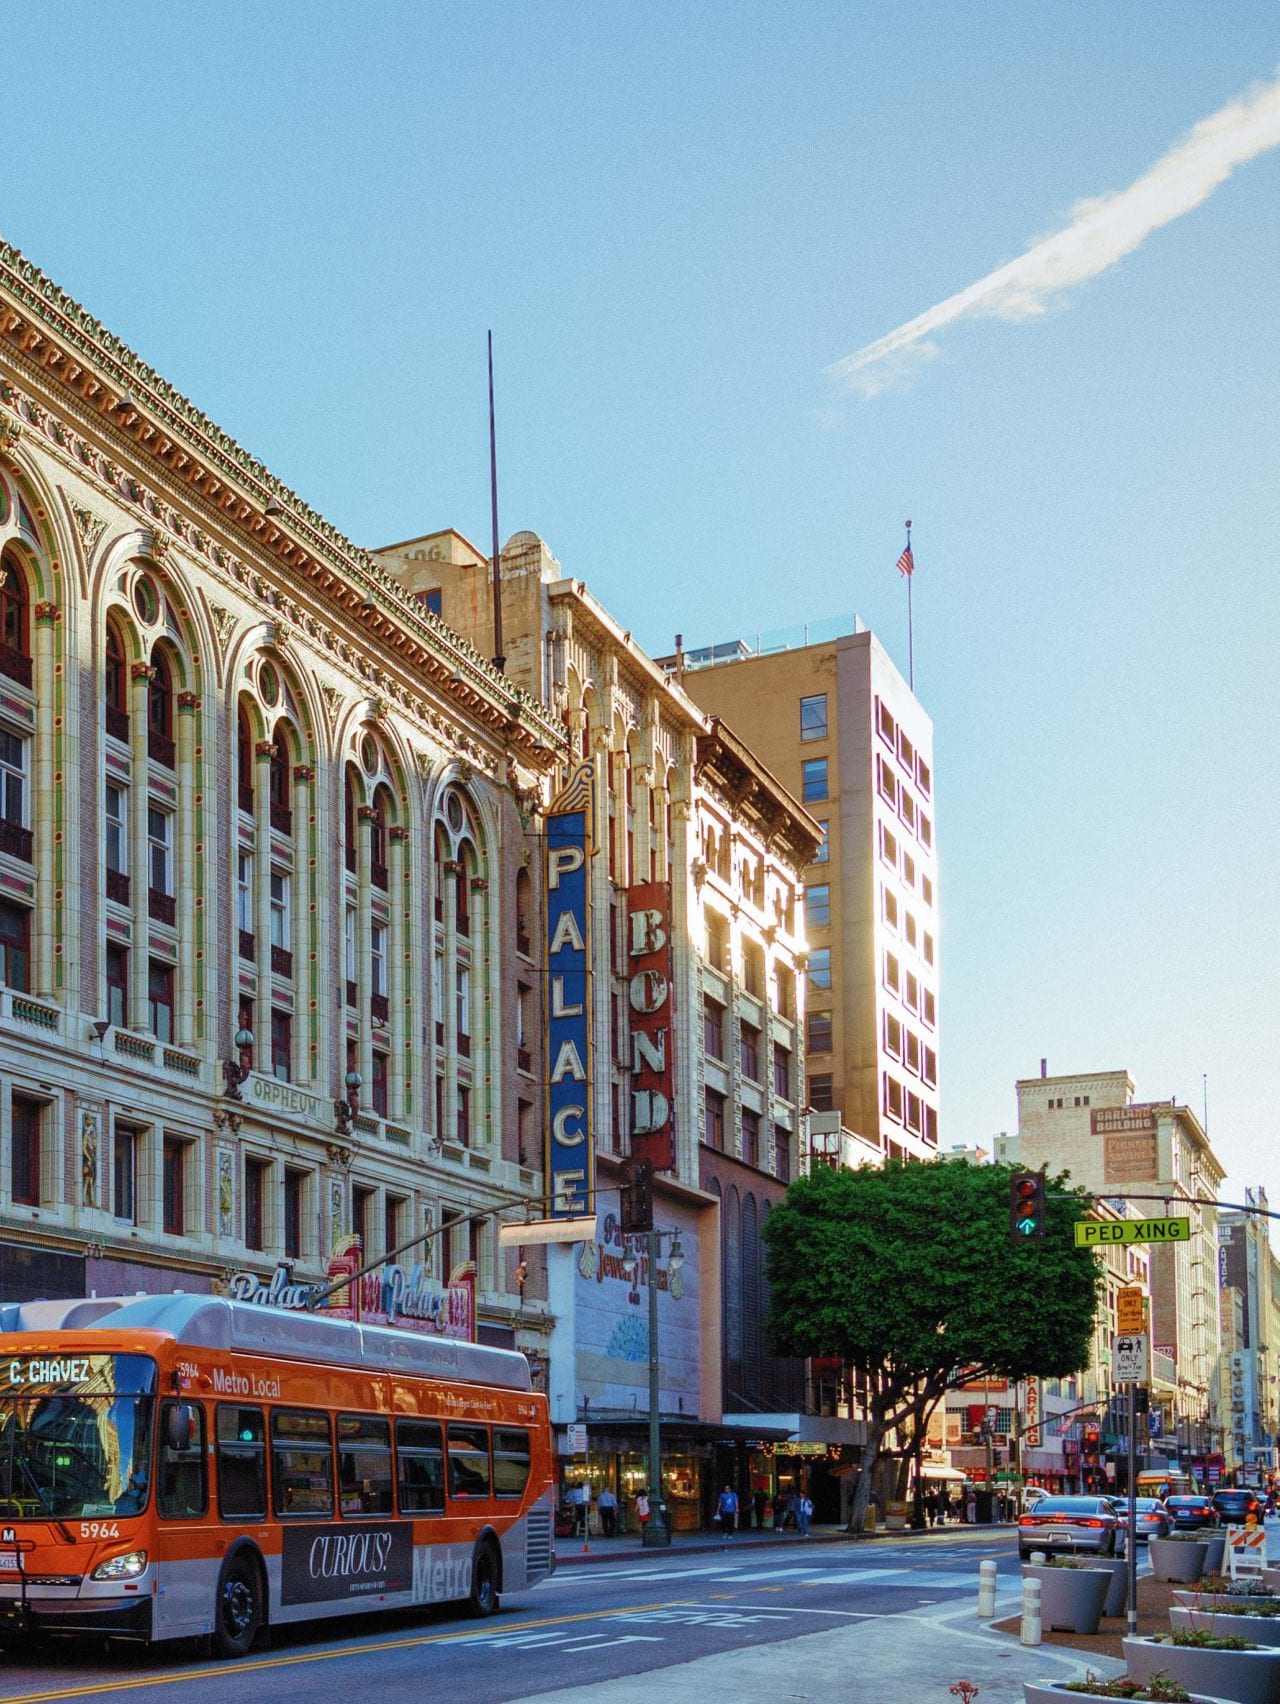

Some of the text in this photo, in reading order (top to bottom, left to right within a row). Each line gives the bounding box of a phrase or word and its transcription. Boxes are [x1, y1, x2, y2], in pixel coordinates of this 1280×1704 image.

[548, 846, 586, 1212] PALACE
[629, 909, 669, 1135] BOND
[254, 1080, 316, 1117] ORPHEUM
[1096, 1118, 1152, 1131] BUILDING
[1085, 1222, 1180, 1241] PED XING
[9, 1361, 25, 1384] C.
[29, 1359, 90, 1383] CHAVEZ
[180, 1362, 199, 1378] 5964
[1121, 1354, 1138, 1362] ONLY
[213, 1368, 281, 1398] Metro Local
[1026, 1377, 1039, 1444] PARKING
[80, 1522, 120, 1539] 5964
[309, 1532, 392, 1579] CURIOUS?
